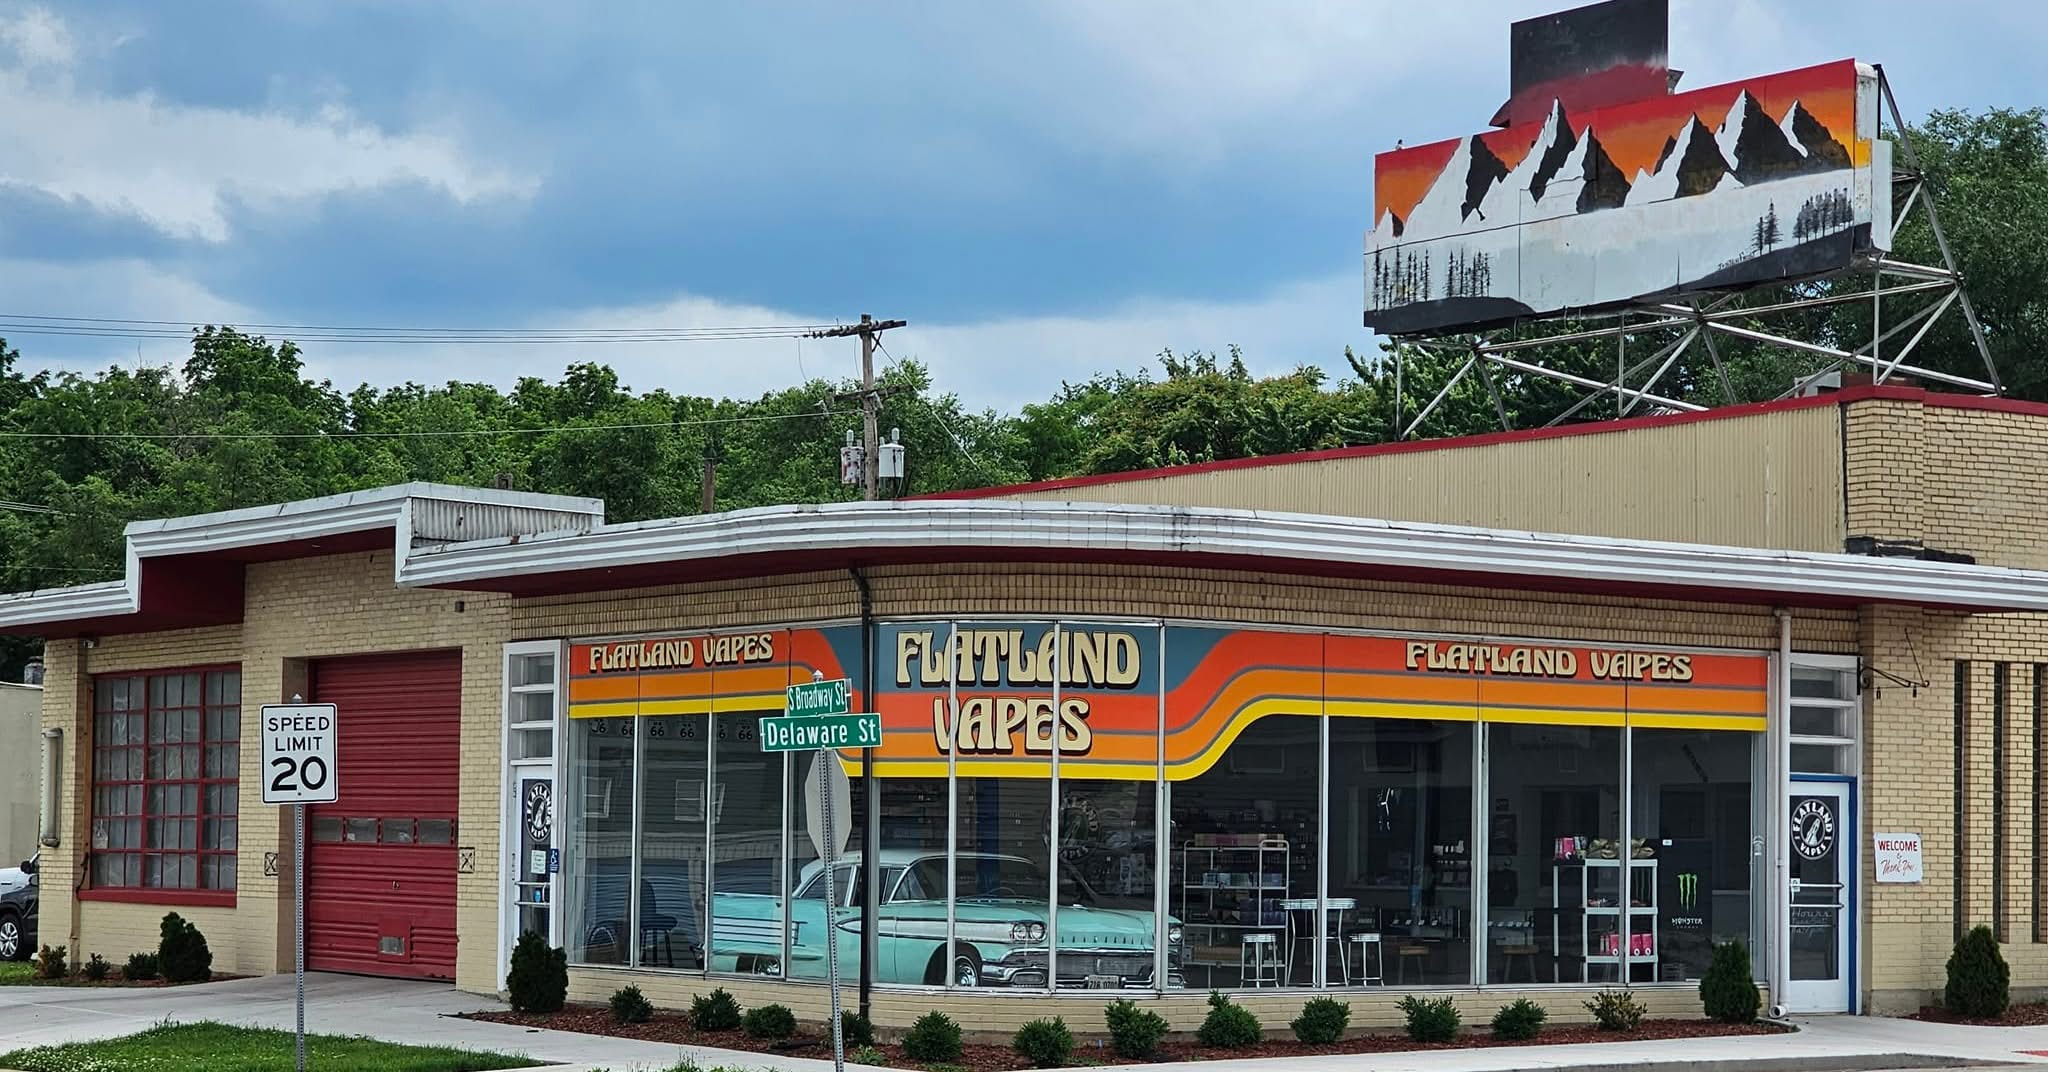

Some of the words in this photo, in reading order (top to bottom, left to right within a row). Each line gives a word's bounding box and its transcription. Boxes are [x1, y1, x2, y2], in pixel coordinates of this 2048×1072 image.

[589, 640, 694, 673] FLATLAND
[702, 633, 774, 665] VAPES
[896, 630, 1140, 688] FLATLAND
[1405, 641, 1578, 676] FLATLAND
[1590, 649, 1693, 682] VAPES
[788, 687, 795, 711] S
[795, 686, 833, 712] Broadway
[835, 682, 845, 706] St
[268, 717, 330, 732] SPEED
[767, 722, 848, 746] Delaware
[858, 719, 876, 742] St
[933, 696, 1093, 755] VAPES
[275, 736, 323, 751] LIMIT
[271, 756, 327, 791] 20
[1793, 802, 1832, 833] FLATLAND
[1800, 843, 1826, 856] VAPES
[1878, 840, 1918, 852] WELCOME
